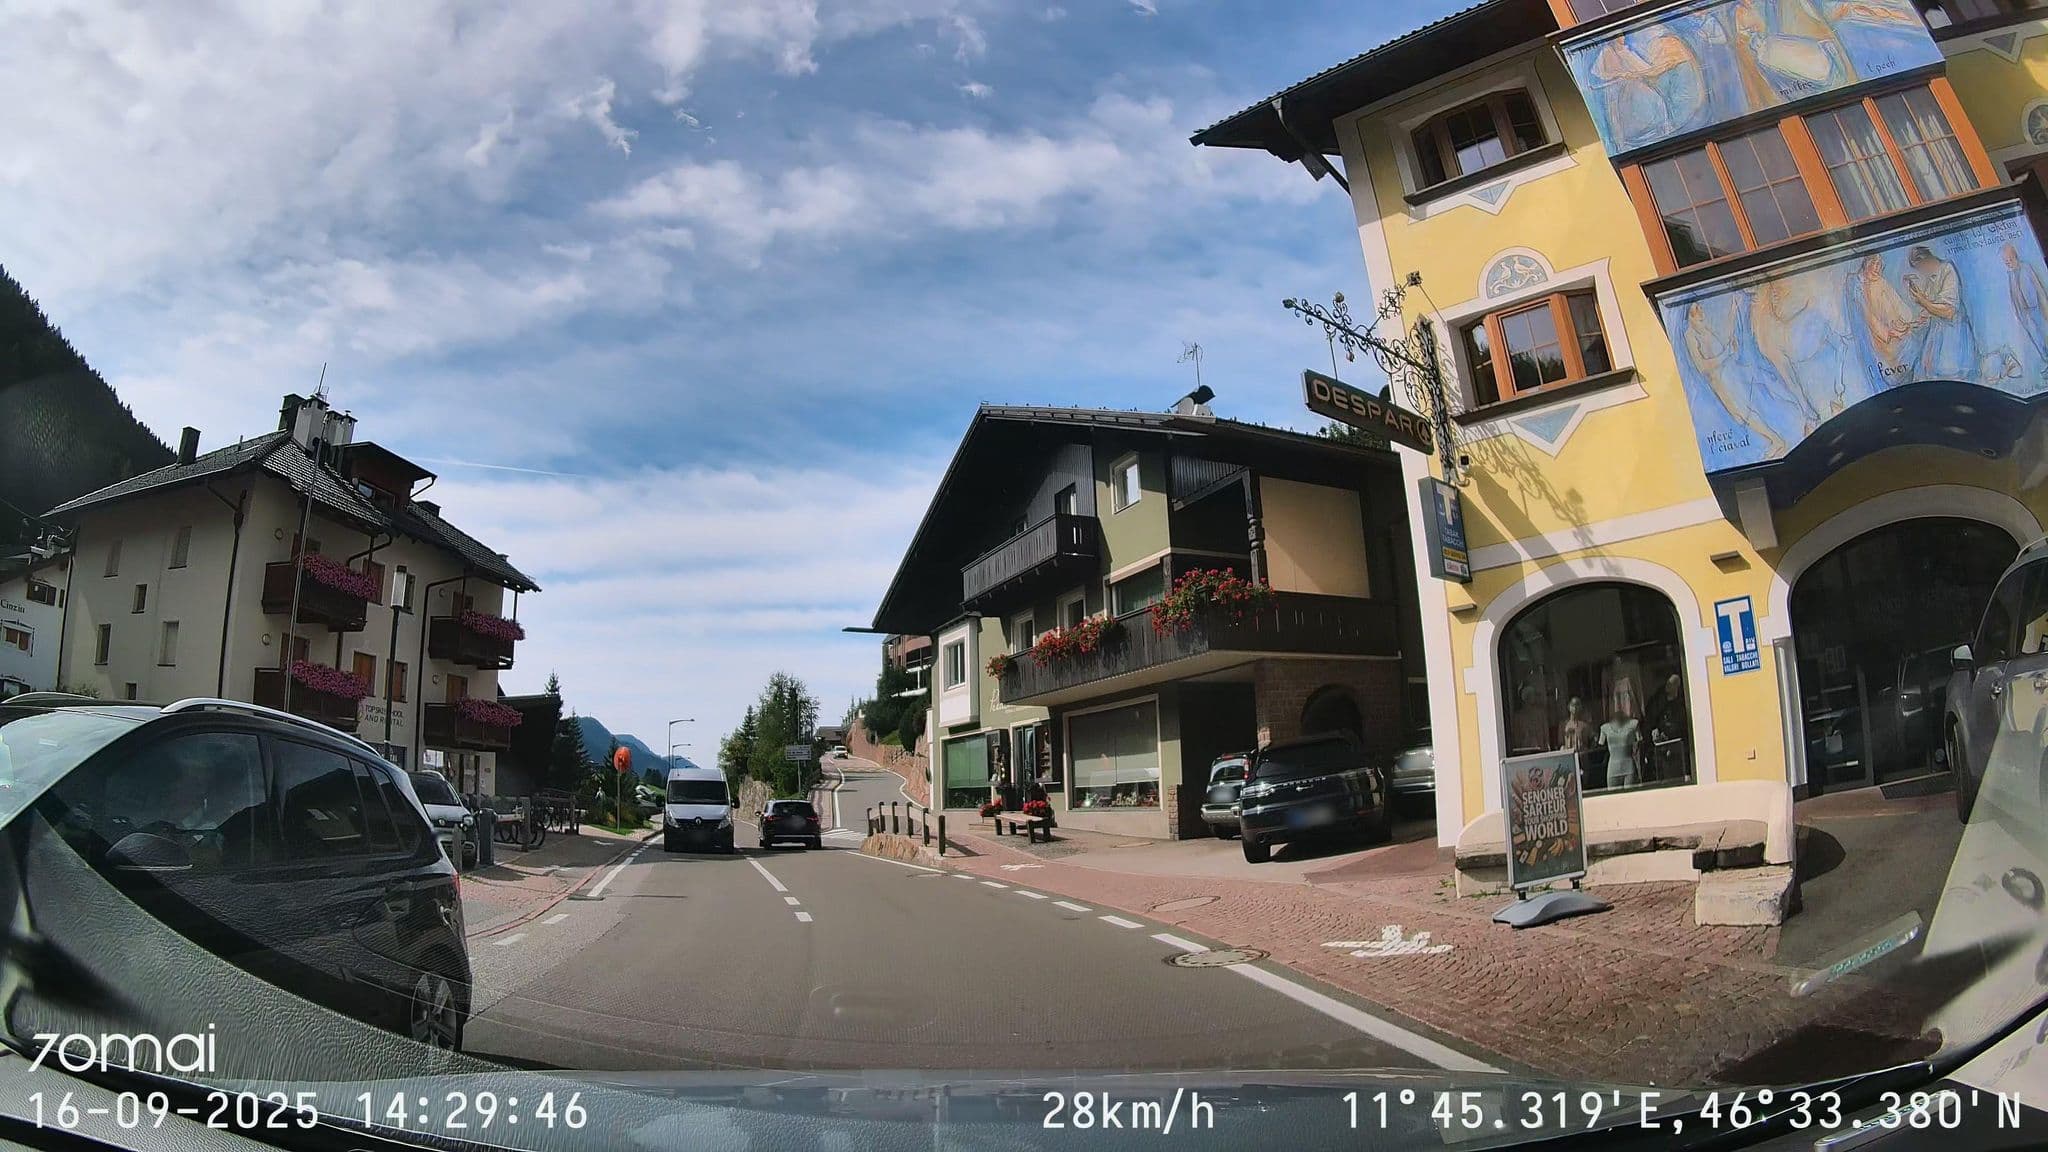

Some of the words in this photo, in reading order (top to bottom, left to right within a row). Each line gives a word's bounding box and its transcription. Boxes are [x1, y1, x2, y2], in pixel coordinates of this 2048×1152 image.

[1312, 379, 1414, 437] DESPAR
[1717, 598, 1750, 653] T
[1522, 787, 1566, 805] SENONER
[1523, 799, 1567, 819] SARTEUR
[1525, 819, 1568, 841] WORLD
